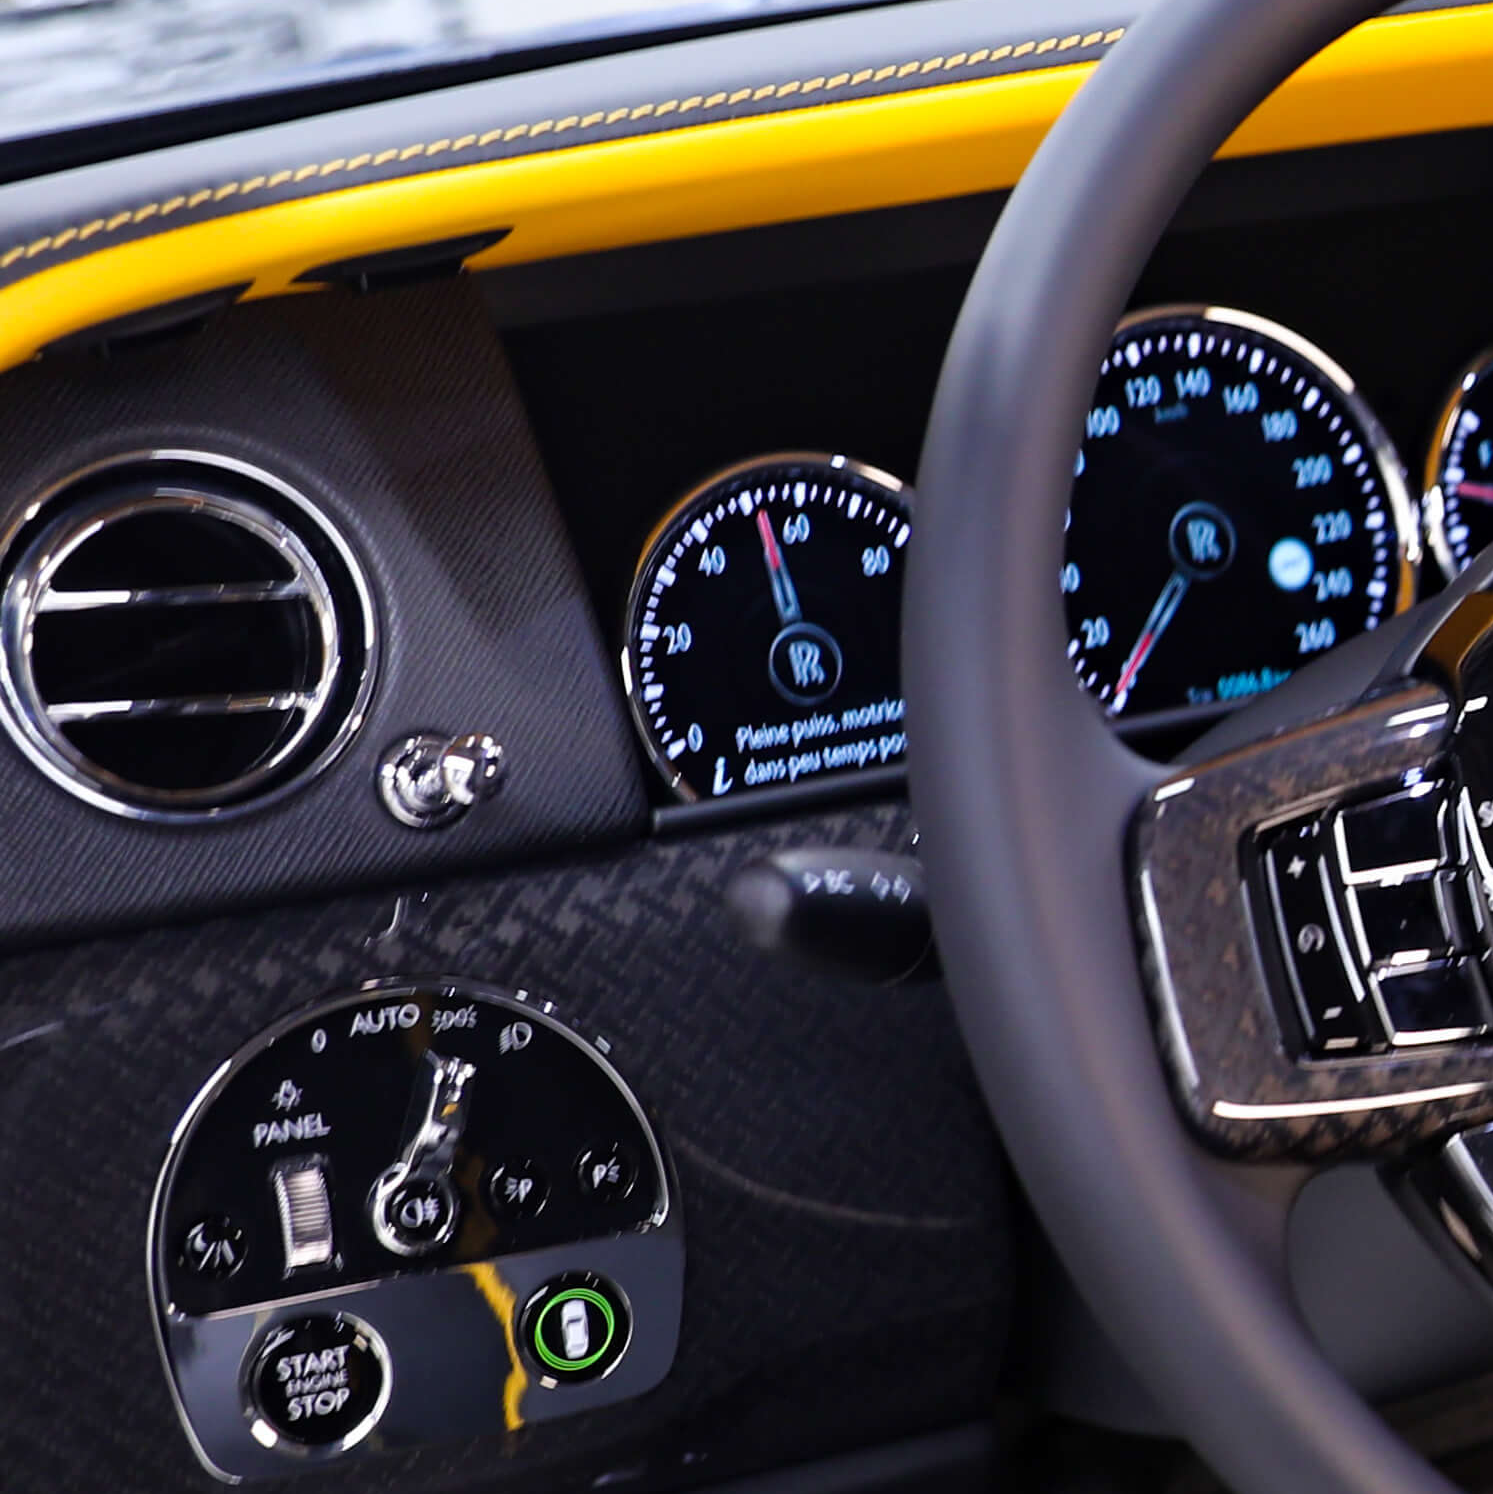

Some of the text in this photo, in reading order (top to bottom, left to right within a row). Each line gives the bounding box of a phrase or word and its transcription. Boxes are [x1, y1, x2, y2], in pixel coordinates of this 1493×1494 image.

[1125, 374, 1161, 408] 120
[1175, 366, 1211, 399] 140
[1223, 381, 1259, 414] 160
[1086, 404, 1120, 439] 100
[1261, 408, 1297, 443] 180
[1291, 453, 1332, 489] 200
[782, 512, 811, 545] 60
[1312, 509, 1353, 545] 220
[698, 545, 726, 577] 40
[861, 545, 891, 577] 80
[1312, 567, 1353, 603] 240
[662, 622, 692, 655] 20
[1081, 615, 1110, 649] 20
[1294, 618, 1336, 654] 260
[687, 722, 703, 753] 0
[735, 721, 790, 754] Pleine
[744, 758, 787, 786] dans
[788, 749, 822, 783] peu
[349, 1003, 421, 1038] AUTO
[253, 1112, 332, 1148] PANEL
[276, 1344, 350, 1382] START
[285, 1368, 349, 1397] ENGINE
[287, 1387, 350, 1422] STOP
